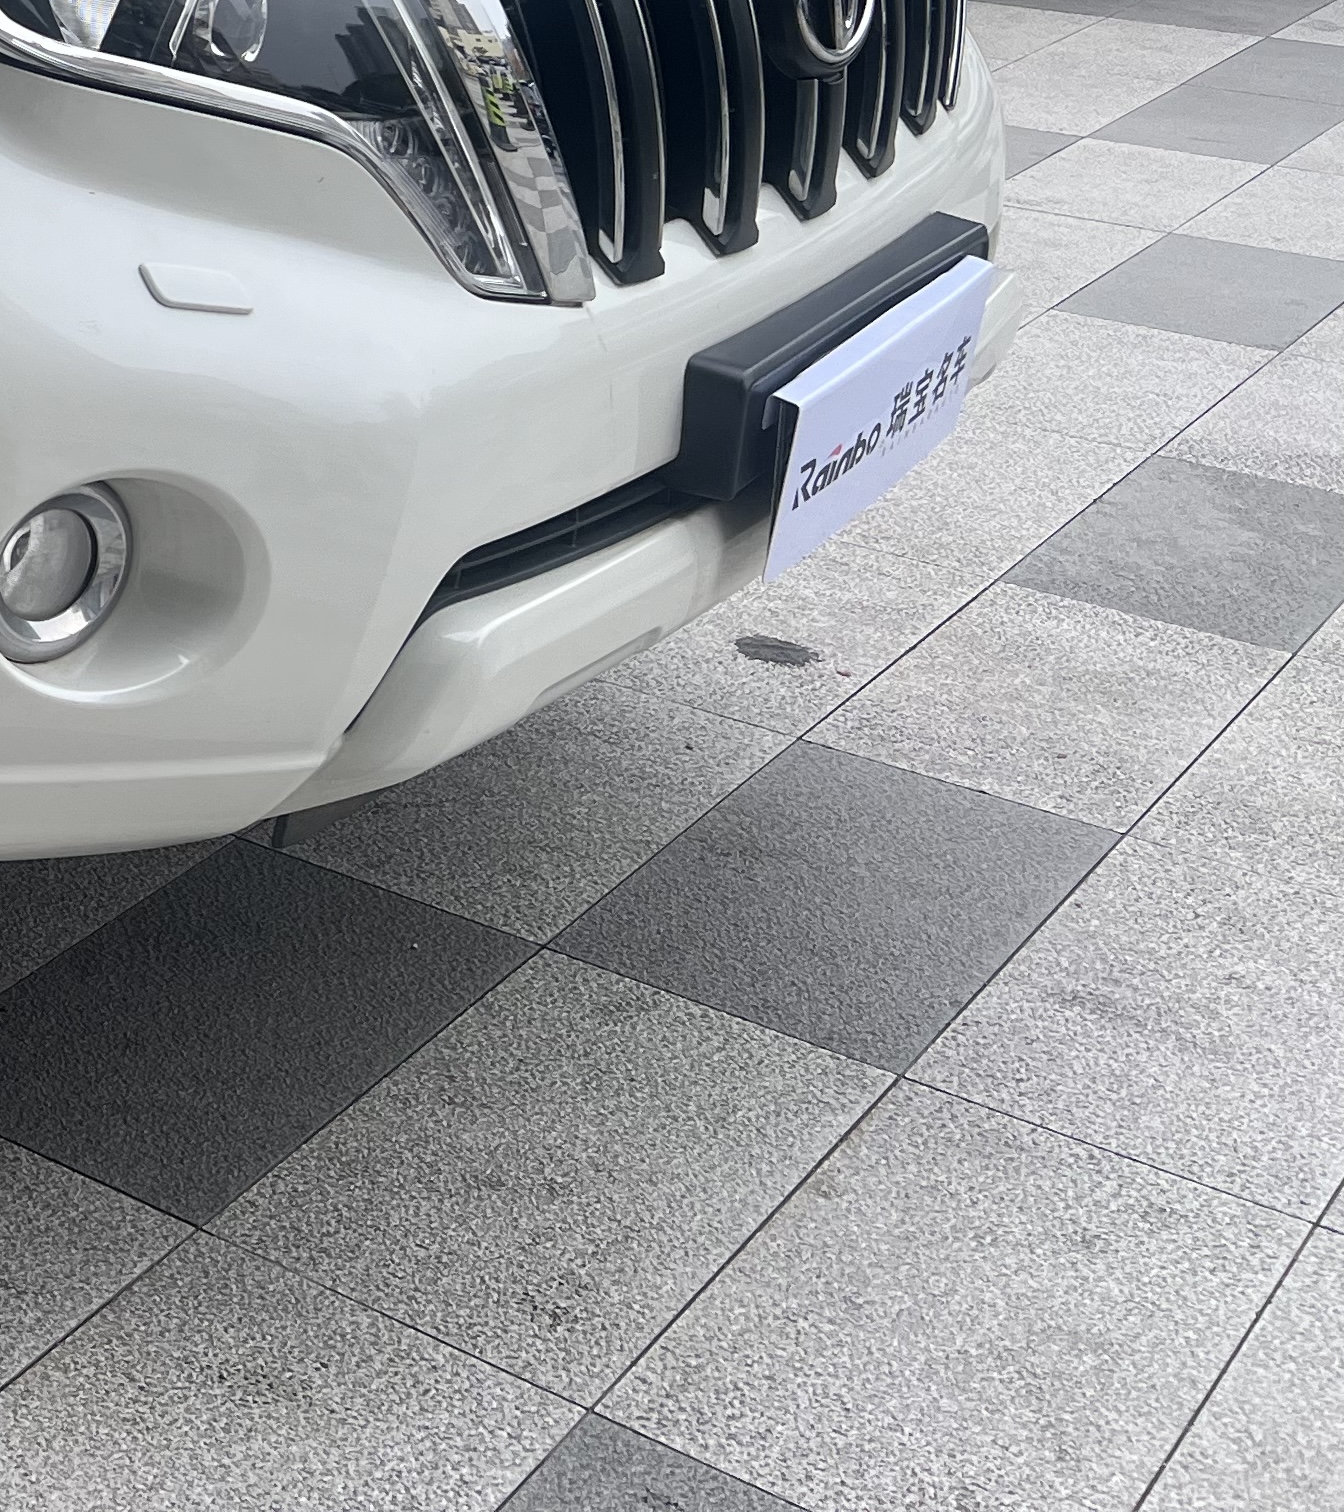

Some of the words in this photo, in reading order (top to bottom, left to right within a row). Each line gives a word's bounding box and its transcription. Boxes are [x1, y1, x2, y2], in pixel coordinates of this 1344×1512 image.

[791, 421, 882, 512] Rainbo
[885, 335, 973, 437] 瑞宝名车
